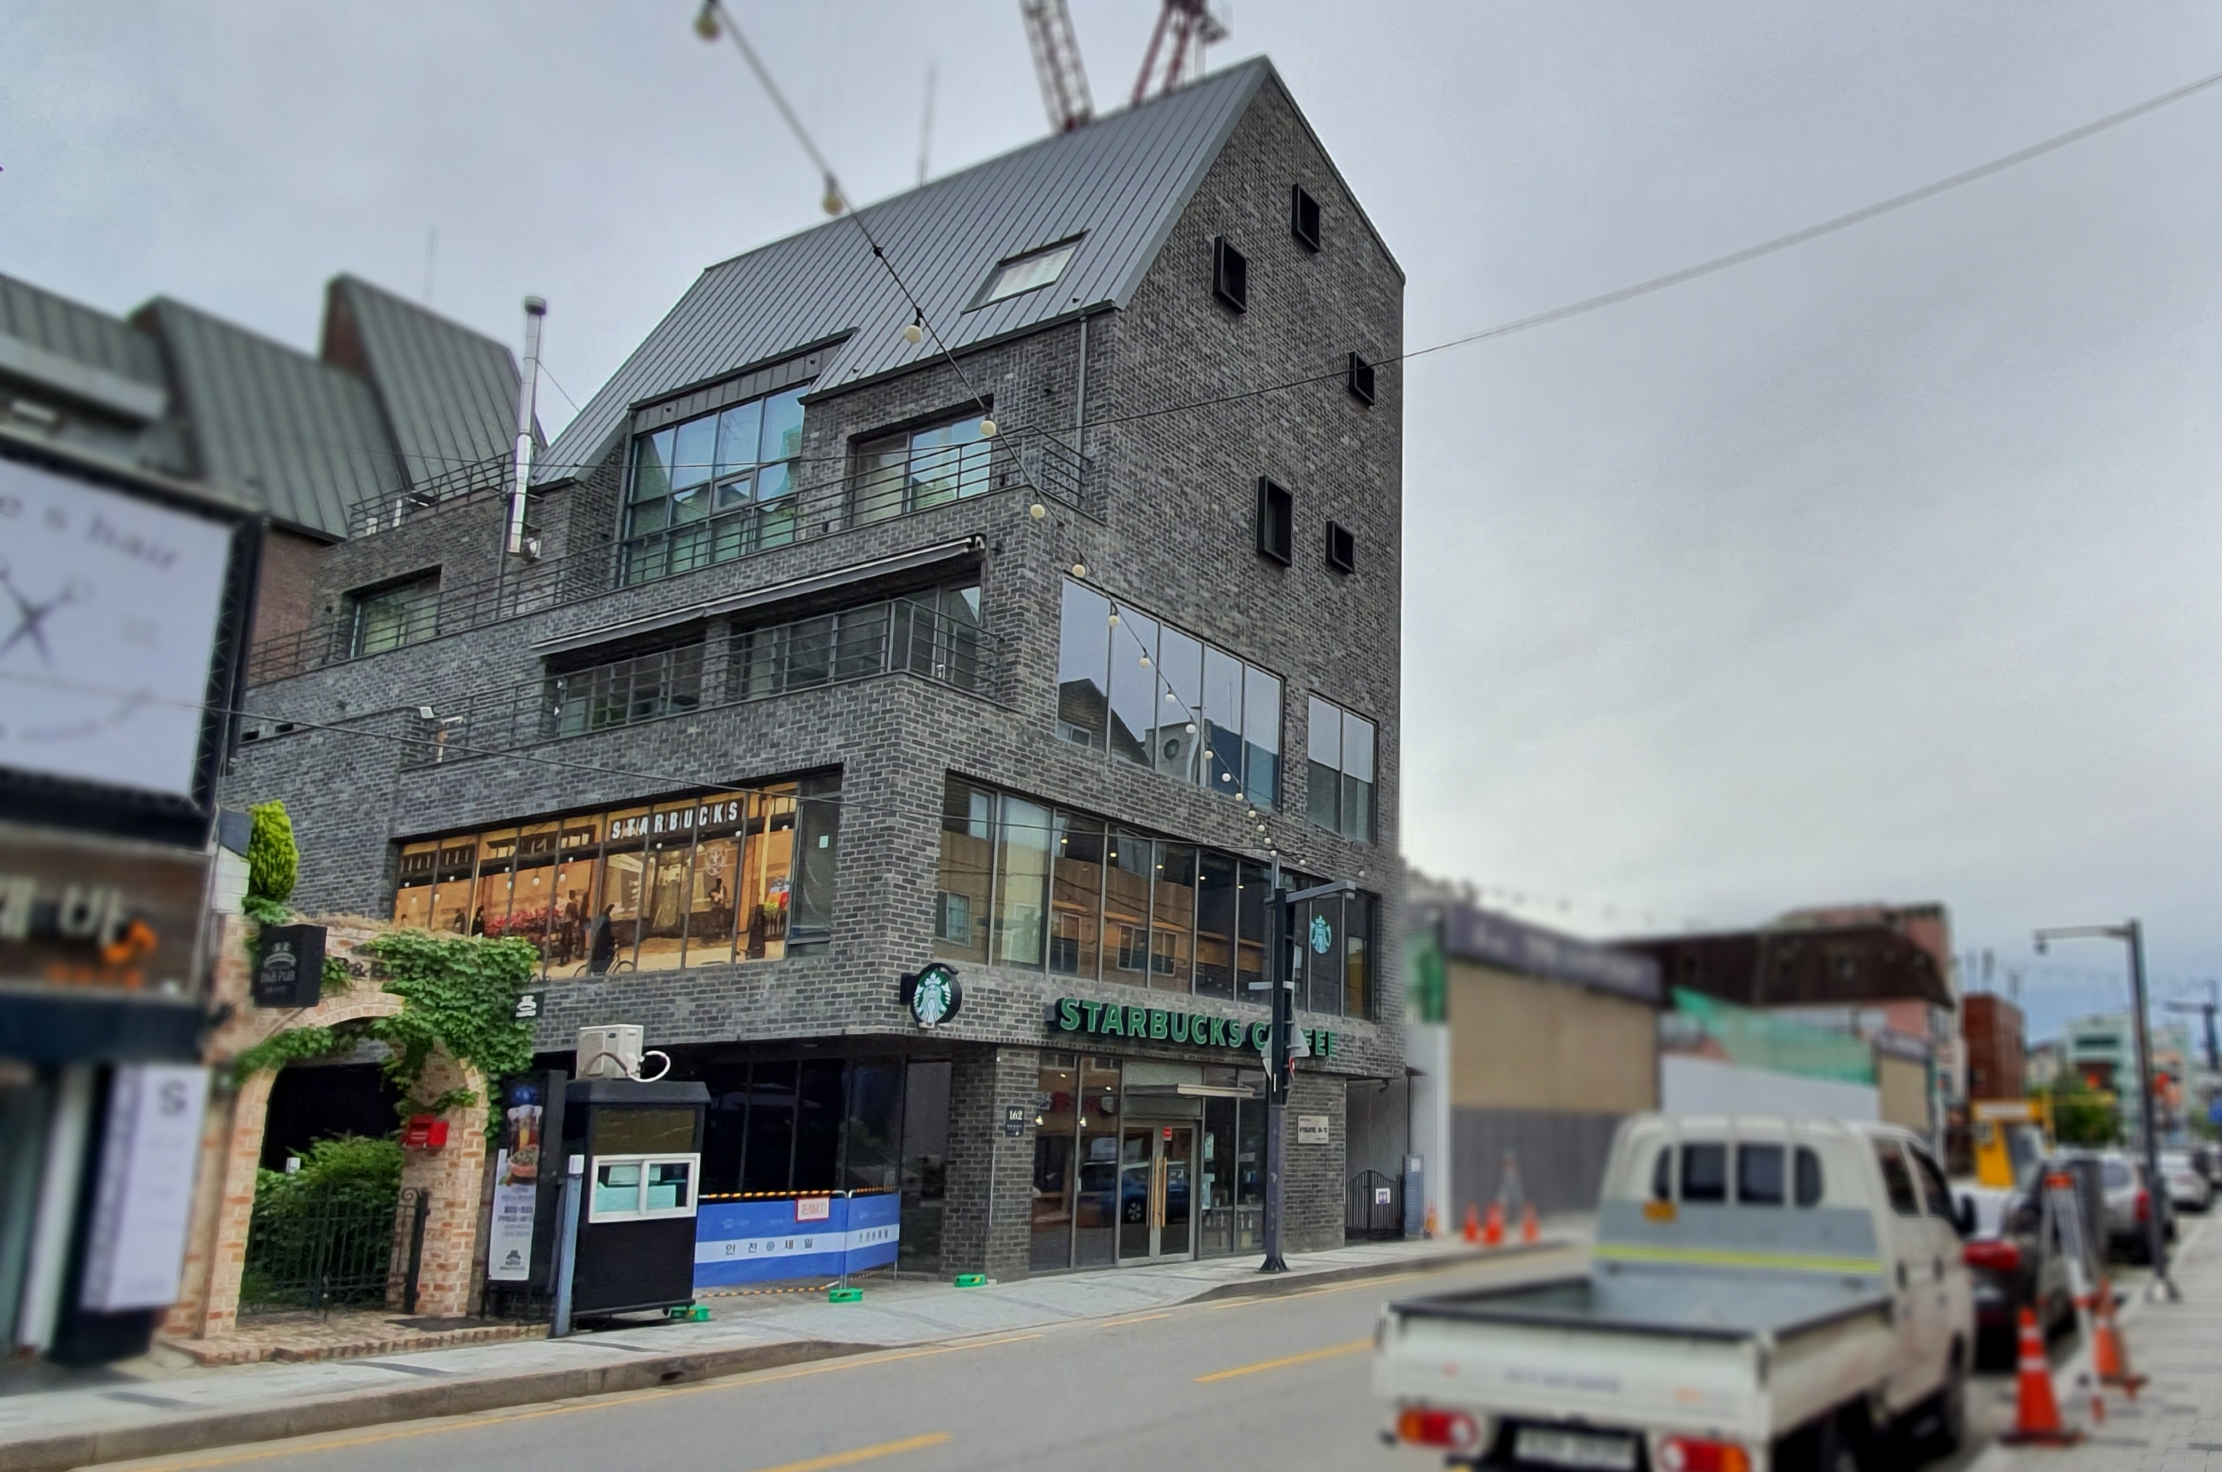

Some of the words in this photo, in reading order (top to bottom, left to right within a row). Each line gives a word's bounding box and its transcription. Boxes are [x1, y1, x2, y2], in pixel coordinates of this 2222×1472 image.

[612, 802, 738, 839] STARBUCKS
[279, 970, 296, 982] PUB
[1060, 997, 1242, 1048] STARBUCKS
[1252, 1021, 1338, 1057] CFEE
[1009, 1110, 1023, 1121] 162
